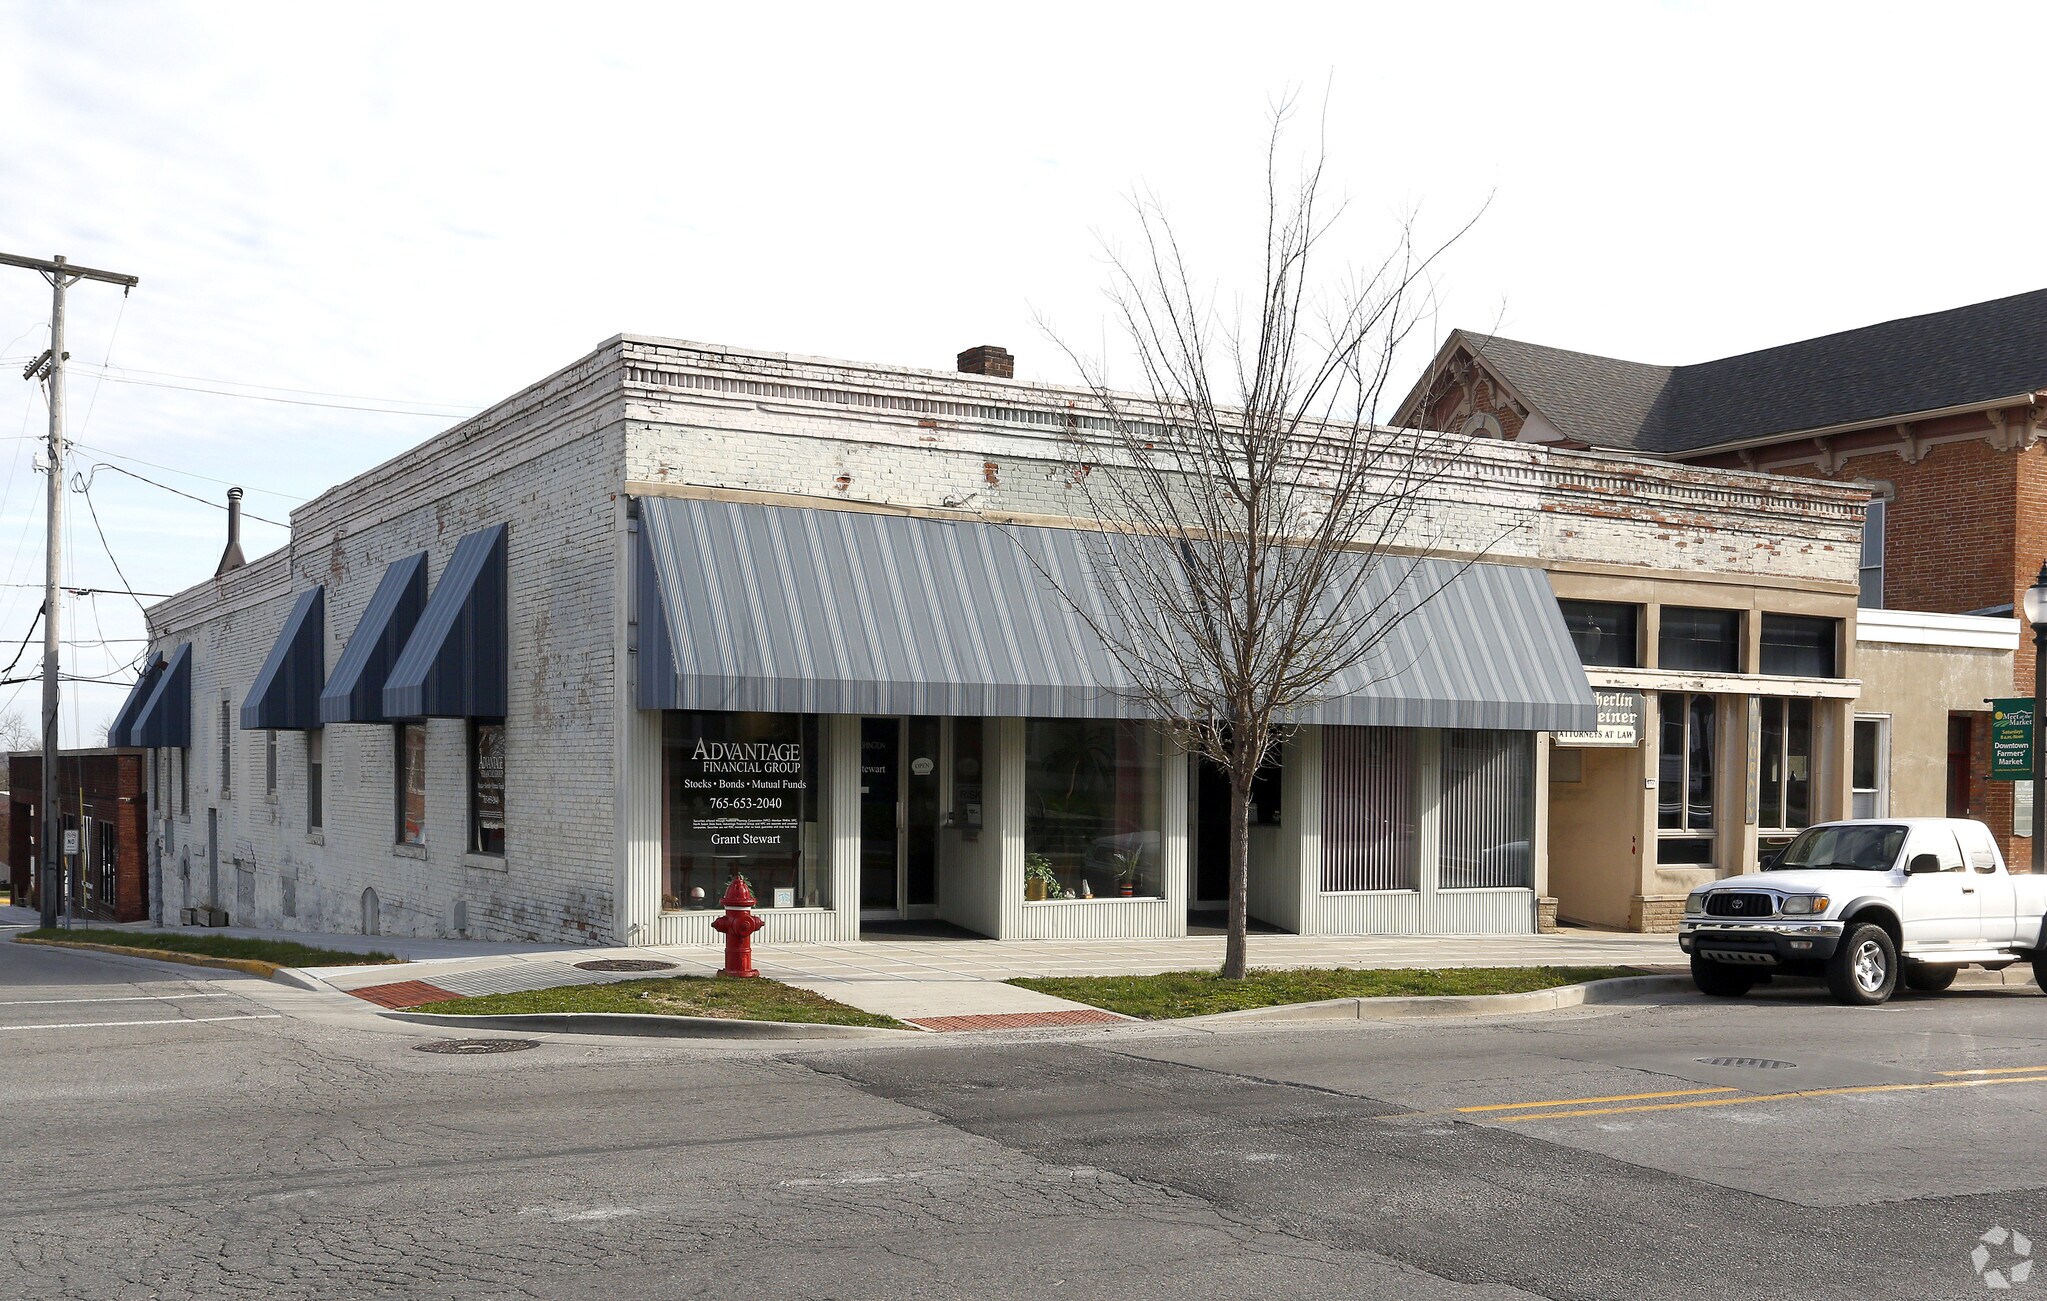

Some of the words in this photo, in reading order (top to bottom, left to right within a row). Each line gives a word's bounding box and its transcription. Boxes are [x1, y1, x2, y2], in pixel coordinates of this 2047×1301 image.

[1593, 692, 1633, 709] herlin
[1598, 709, 1638, 724] einer
[1605, 731, 1614, 739] AT
[1617, 731, 1634, 739] LAW
[691, 737, 801, 762] ADVANTAGE
[703, 761, 762, 773] FINANCIAL
[764, 762, 801, 773] GROUP
[861, 765, 886, 773] tewart
[684, 779, 712, 789] Stocks
[719, 779, 745, 789] Bonds
[751, 779, 780, 789] Mutual
[782, 779, 807, 789] Funds
[709, 798, 782, 809] 765-653-2040
[711, 834, 740, 845] Grant
[742, 833, 781, 845] Stewart
